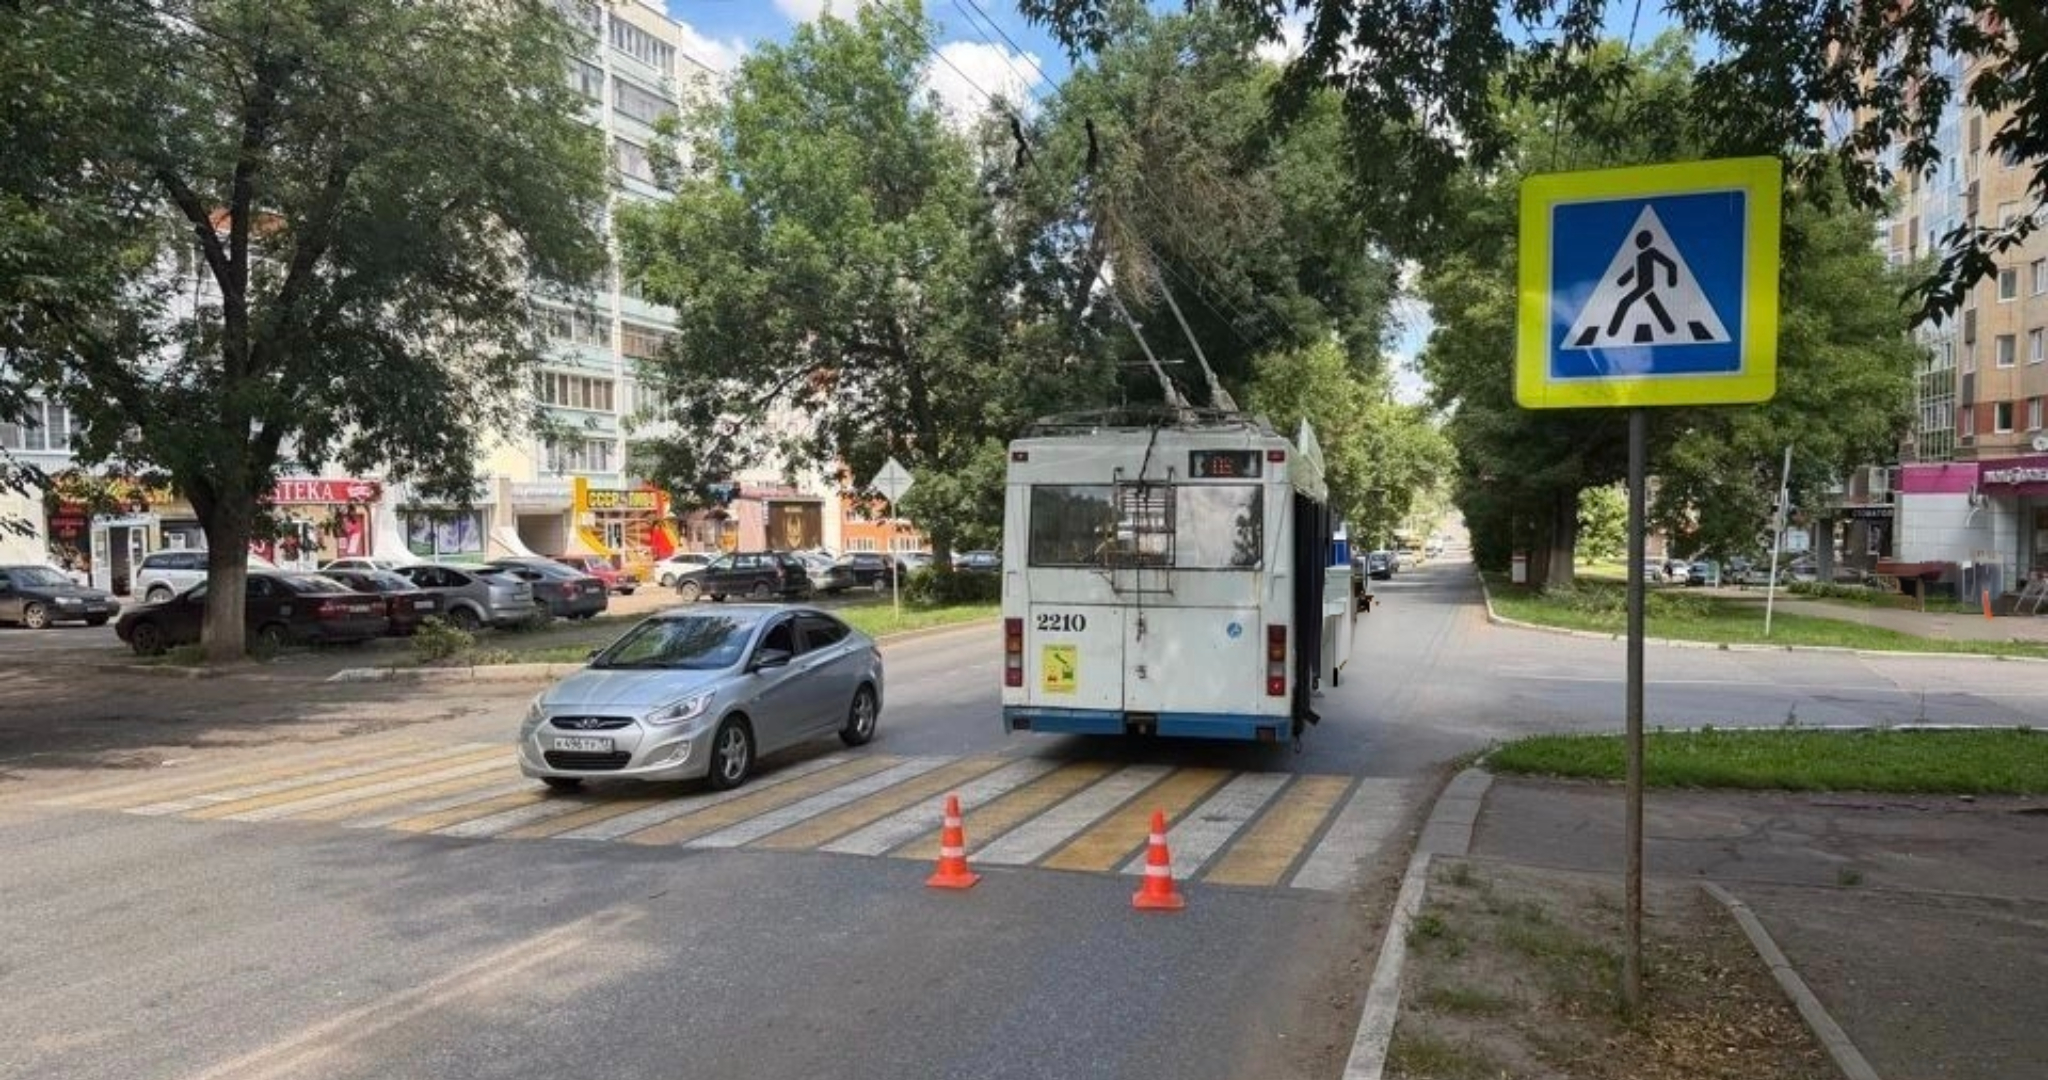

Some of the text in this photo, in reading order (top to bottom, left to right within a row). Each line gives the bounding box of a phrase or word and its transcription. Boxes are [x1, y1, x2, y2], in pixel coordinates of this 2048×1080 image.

[273, 481, 334, 500] ТЕКА
[588, 491, 620, 508] СССР
[1036, 613, 1087, 632] 2210
